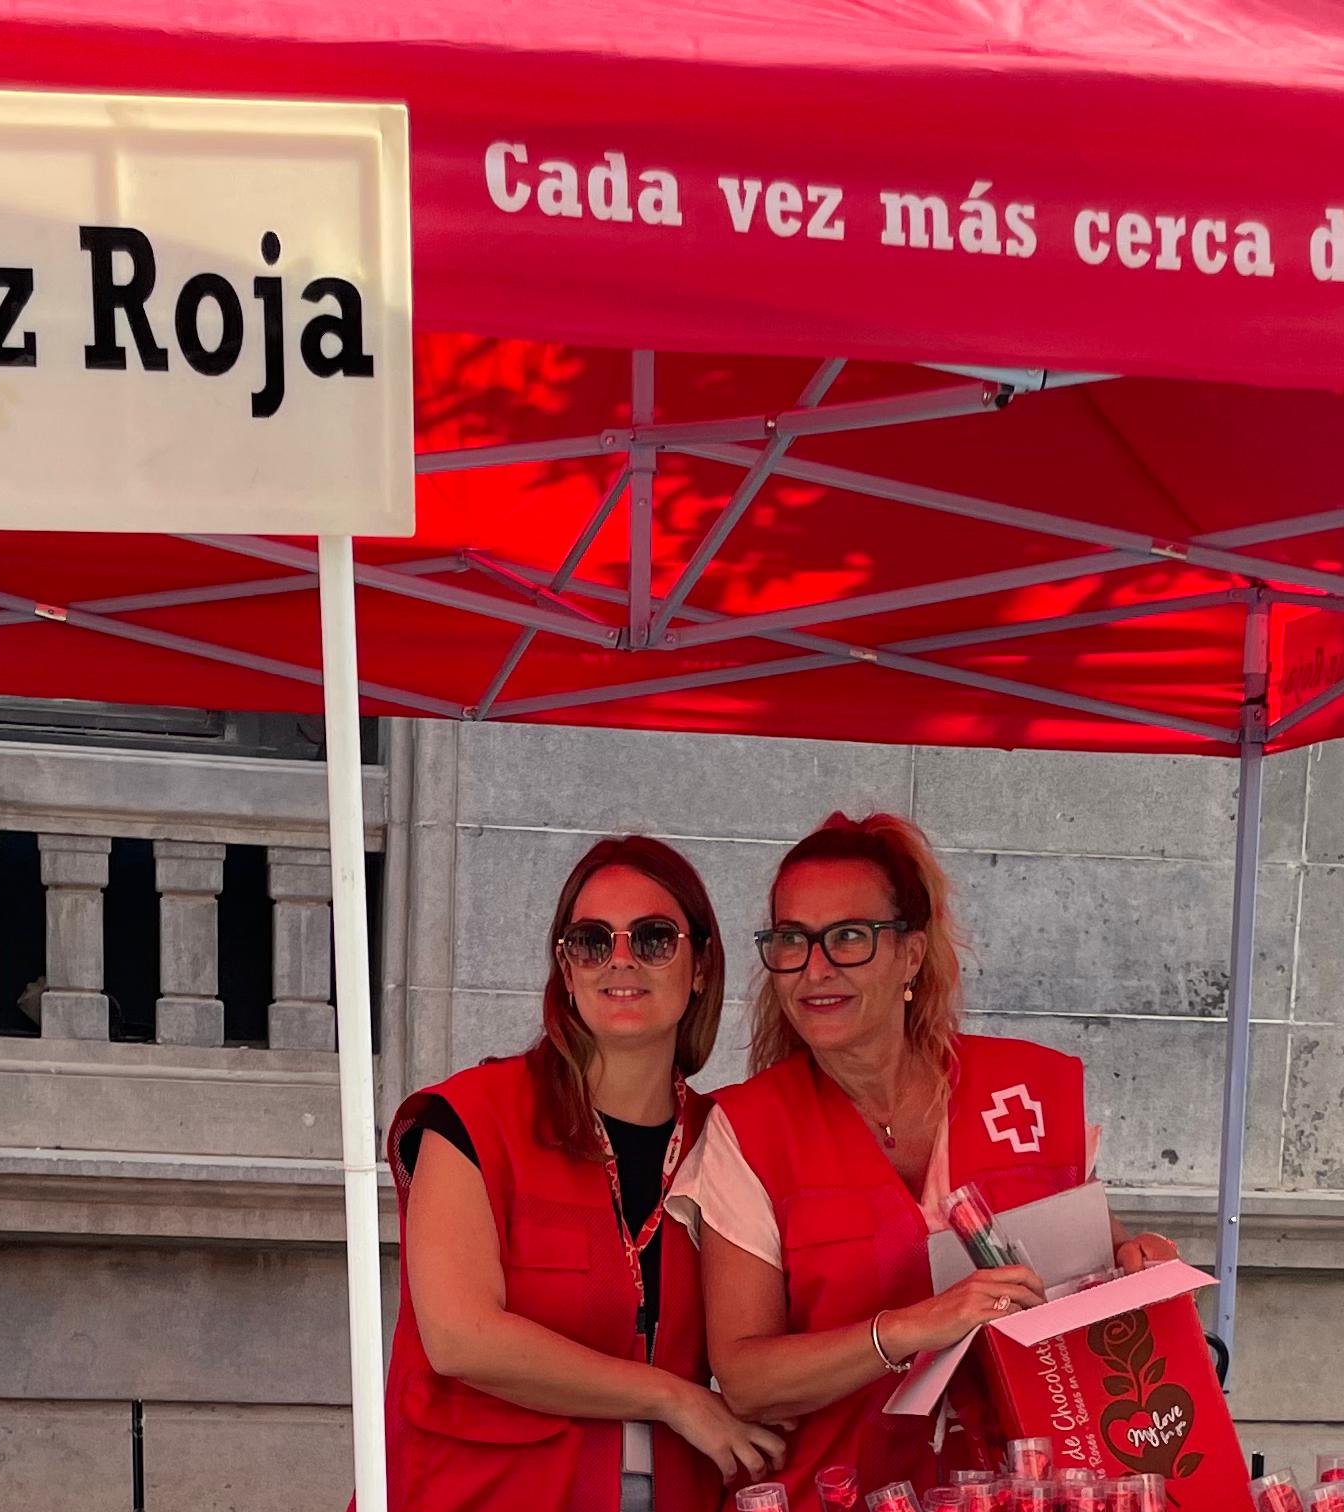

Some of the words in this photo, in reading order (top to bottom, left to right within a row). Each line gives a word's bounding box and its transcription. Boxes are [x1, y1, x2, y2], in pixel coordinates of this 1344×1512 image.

[485, 141, 682, 226] Cada
[717, 174, 845, 240] vez
[880, 181, 1037, 257] más
[1074, 207, 1275, 278] cerca
[80, 225, 375, 418] Roja
[1061, 1435, 1086, 1460] de
[1127, 1426, 1159, 1447] My
[1152, 1405, 1183, 1430] love
